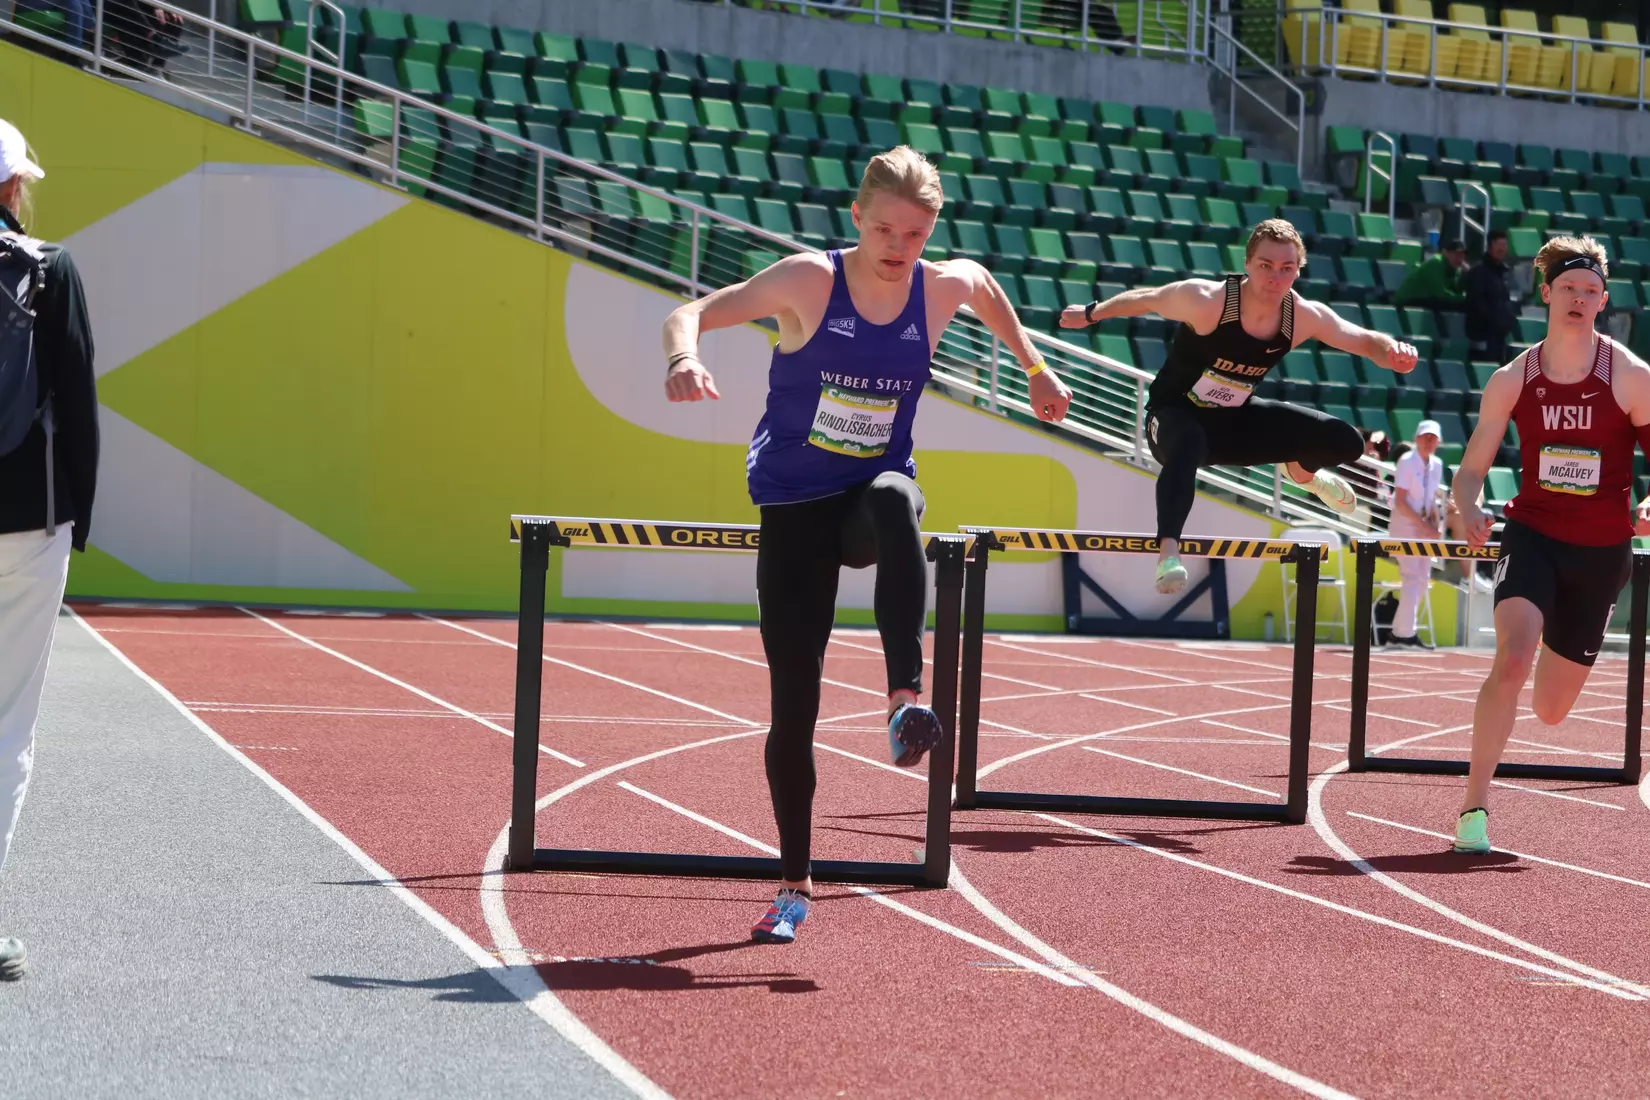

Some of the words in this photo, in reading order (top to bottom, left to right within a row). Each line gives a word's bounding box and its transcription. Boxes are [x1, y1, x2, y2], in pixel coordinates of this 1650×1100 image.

[900, 333, 921, 341] adidas
[1213, 357, 1268, 376] IDAHO
[820, 370, 869, 389] WEBER
[876, 378, 912, 391] STATE
[1206, 388, 1235, 402] AYERS
[816, 411, 893, 438] RINDLISBACHER
[851, 413, 872, 422] CYRUS
[1541, 405, 1592, 430] WSU
[1548, 465, 1594, 480] MCALVEY
[562, 527, 589, 537] GILL
[671, 529, 760, 546] OREG
[999, 535, 1020, 543] GILL
[1085, 537, 1201, 553] OREGN
[1266, 546, 1287, 555] GILL
[1455, 546, 1501, 557] ORE
